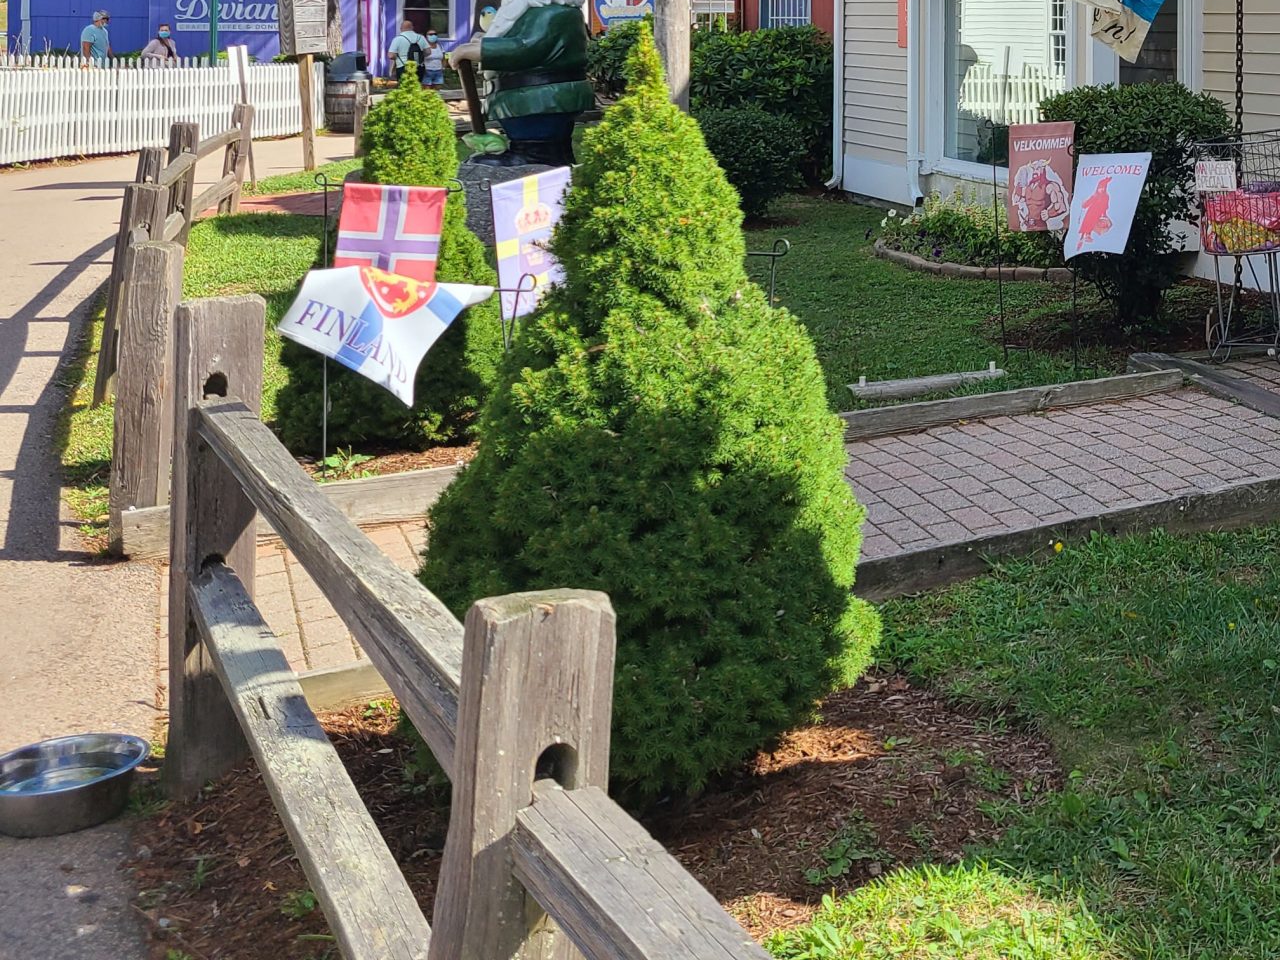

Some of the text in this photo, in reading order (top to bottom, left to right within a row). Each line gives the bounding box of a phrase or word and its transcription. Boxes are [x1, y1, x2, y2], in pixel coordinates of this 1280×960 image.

[1013, 137, 1072, 152] VELKOMMEN
[1082, 164, 1143, 177] WELCOME
[295, 299, 407, 384] FINLAND
